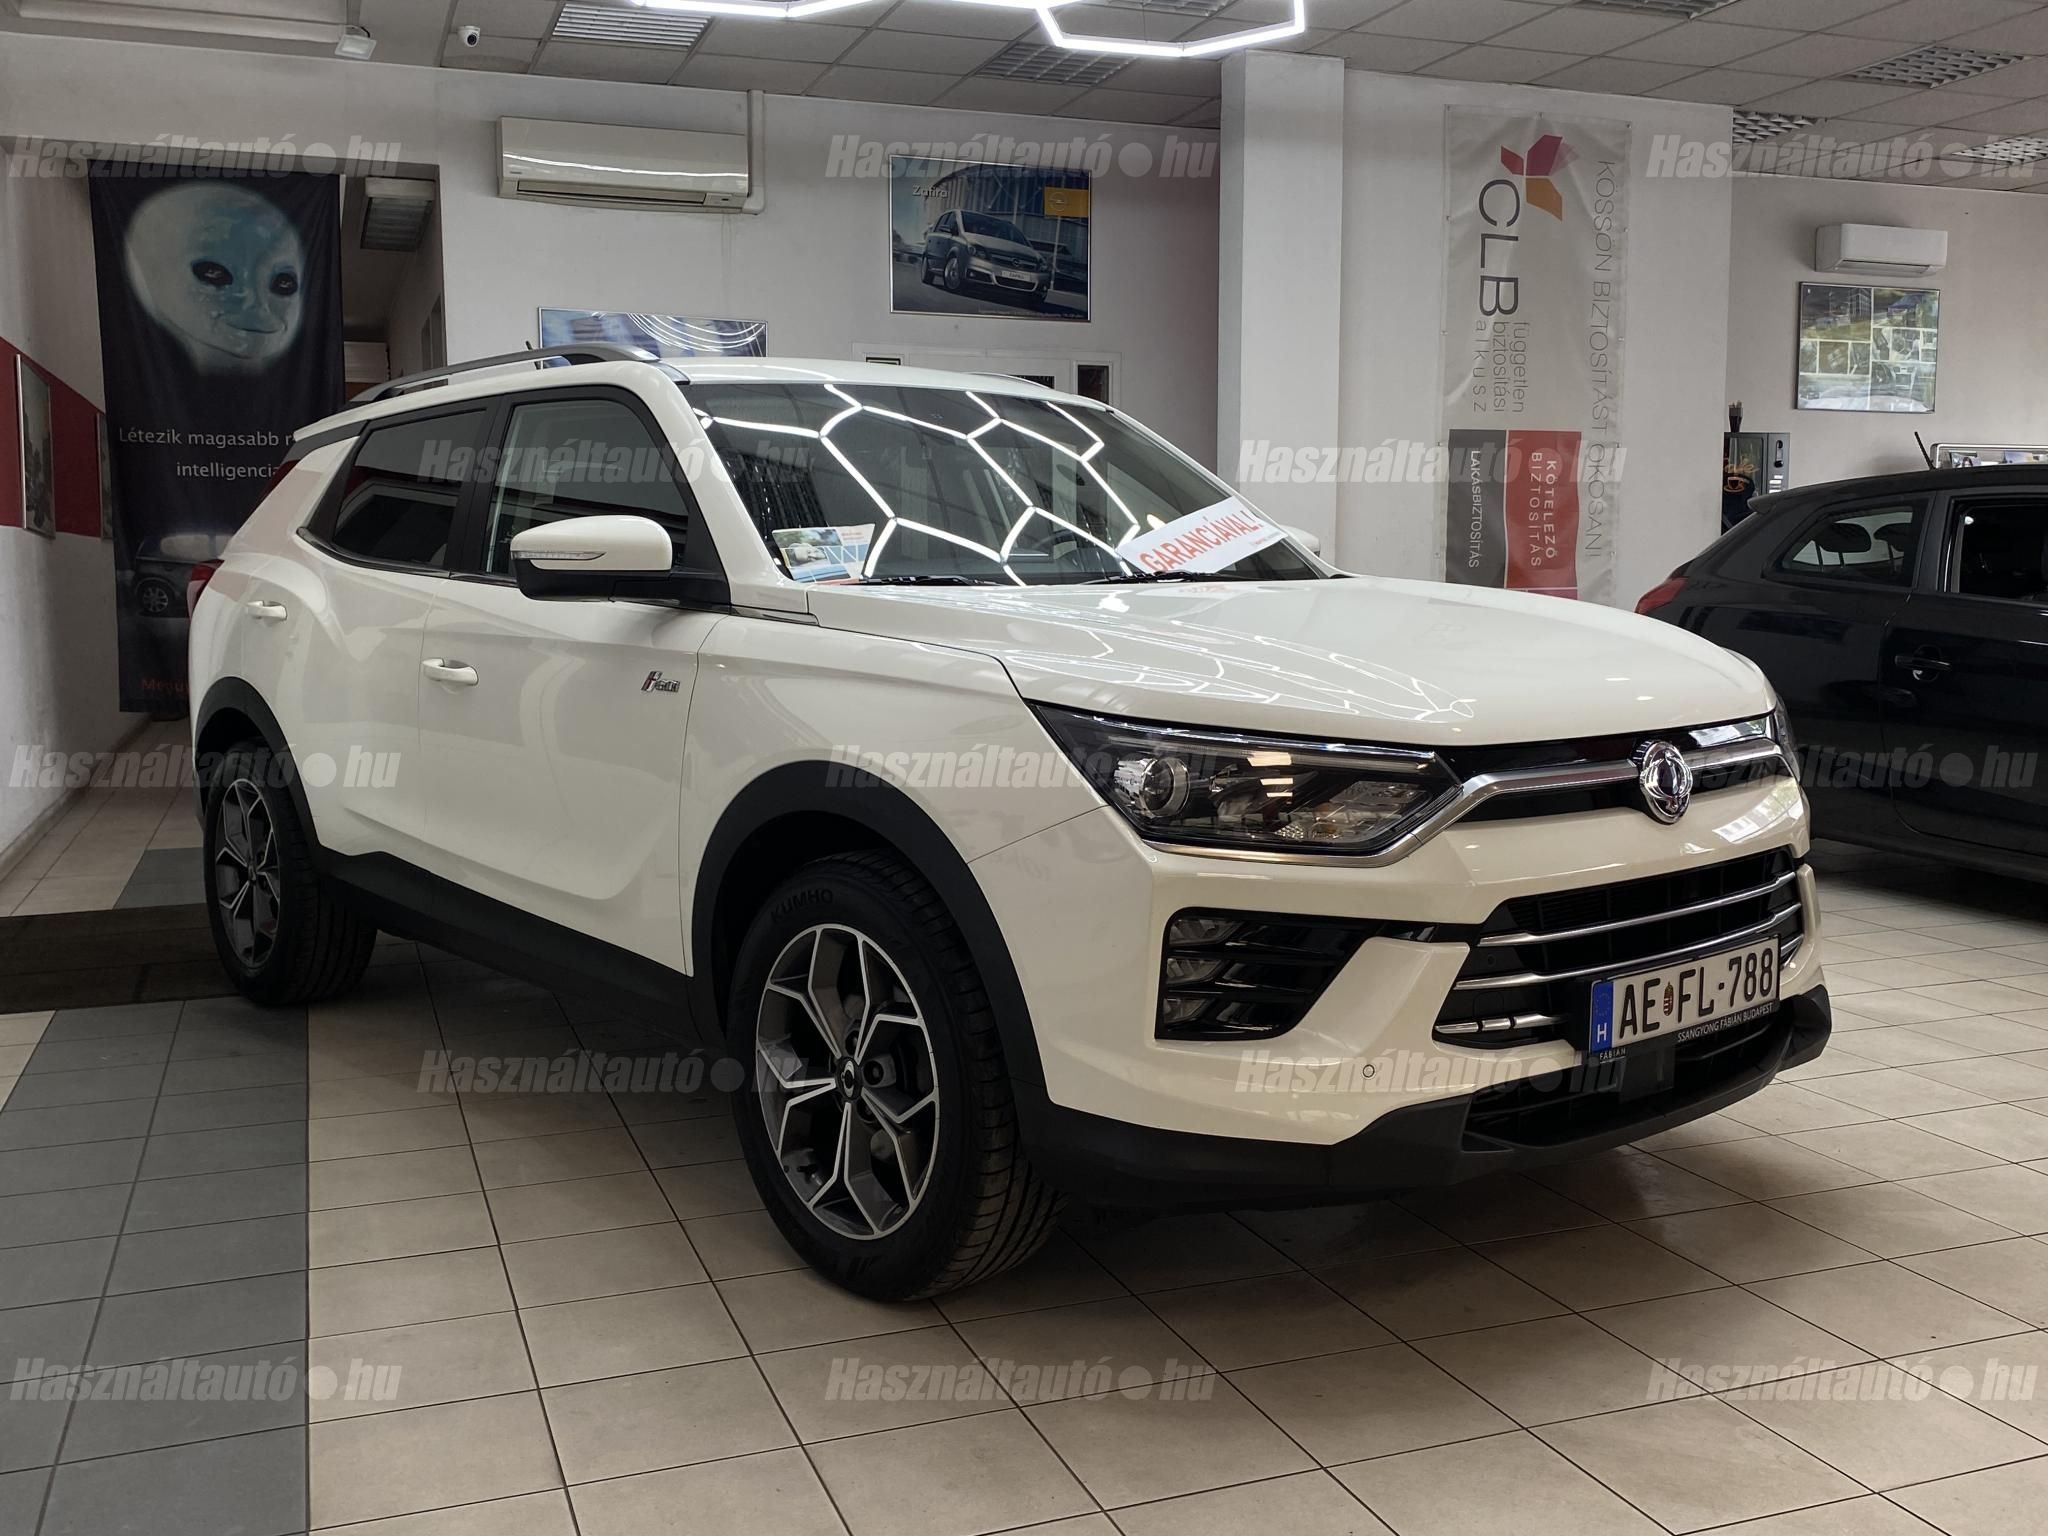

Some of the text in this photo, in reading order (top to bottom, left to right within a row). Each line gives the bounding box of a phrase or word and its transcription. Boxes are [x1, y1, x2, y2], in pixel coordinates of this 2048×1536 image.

[912, 184, 949, 198] Zafira
[1478, 179, 1520, 317] CLB
[119, 427, 182, 444] Létezik
[188, 431, 279, 448] magasabb
[770, 888, 834, 922] KUMHO
[1596, 1022, 1608, 1043] H
[1677, 1021, 1720, 1043] SSANGYONG
[1742, 1002, 1774, 1021] BUDAPEST
